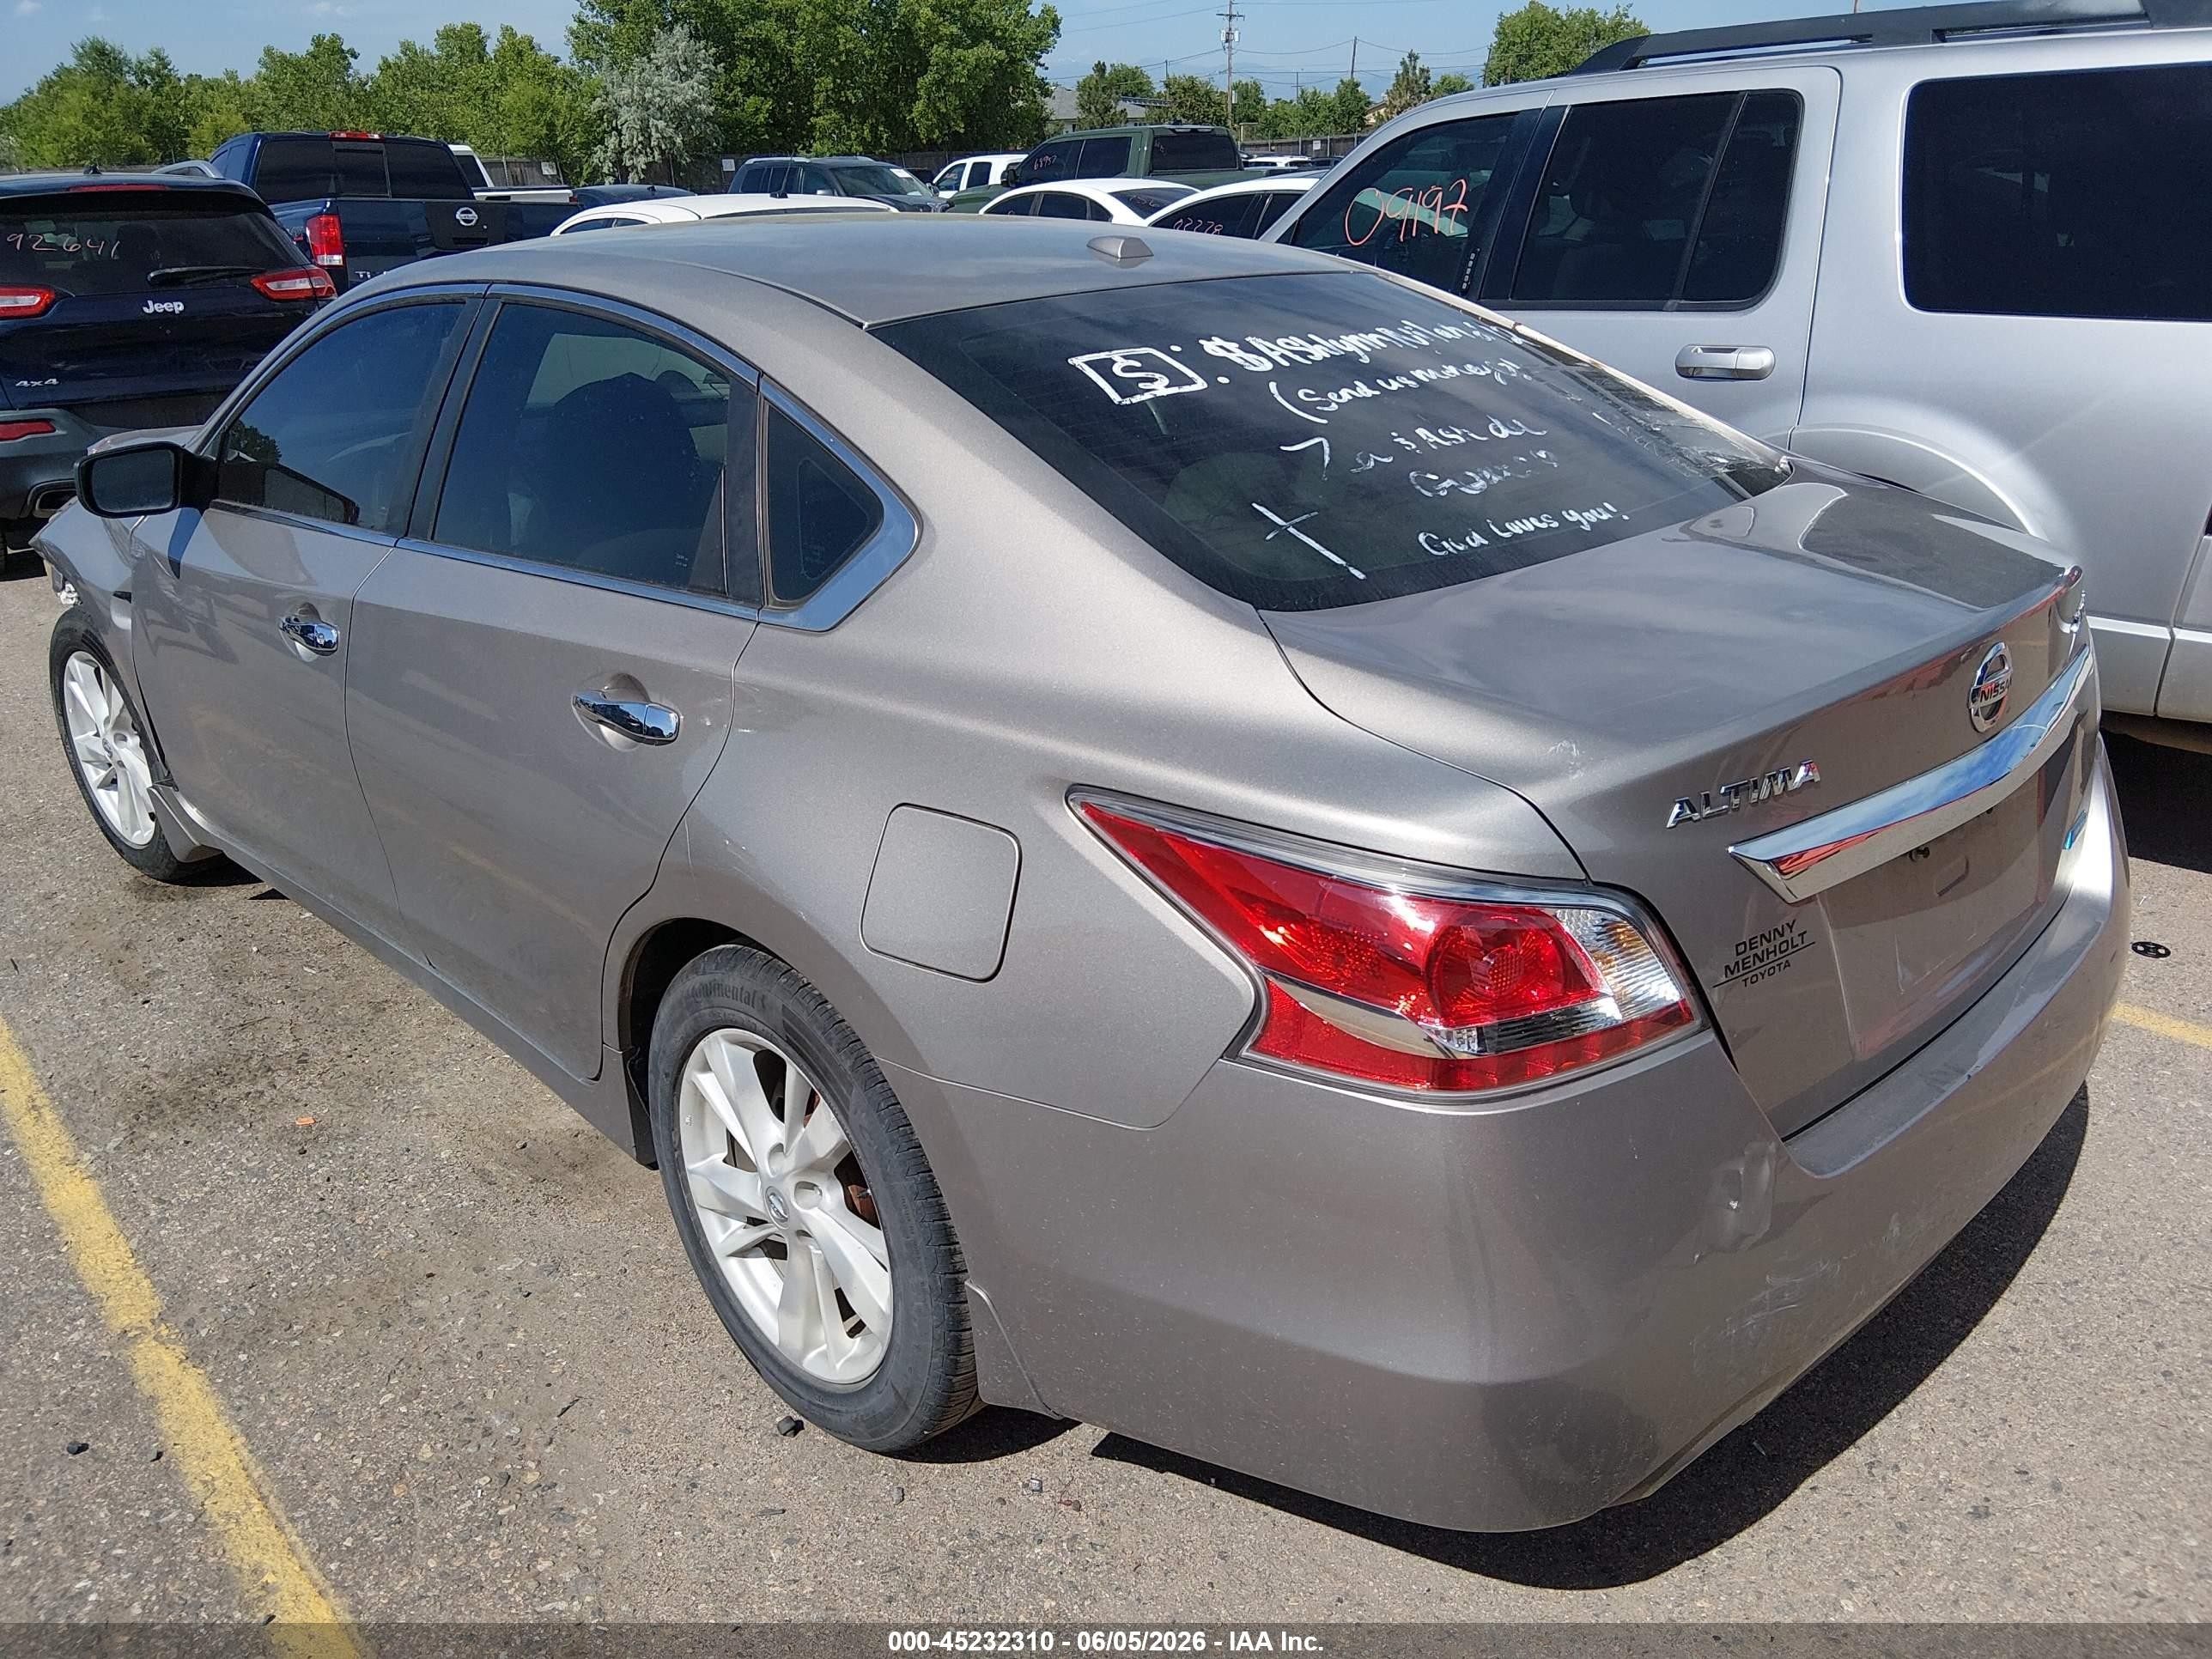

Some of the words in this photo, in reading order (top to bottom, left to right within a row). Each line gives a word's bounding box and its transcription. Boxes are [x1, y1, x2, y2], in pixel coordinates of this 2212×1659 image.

[1345, 170, 1468, 246] 09197
[6, 233, 120, 259] 92641
[143, 301, 185, 314] Jeep
[1666, 759, 1820, 829] ALTIMA
[1724, 930, 1808, 978] MENHOLT
[1735, 919, 1796, 957] DENNY
[1741, 959, 1791, 988] TOYOTA
